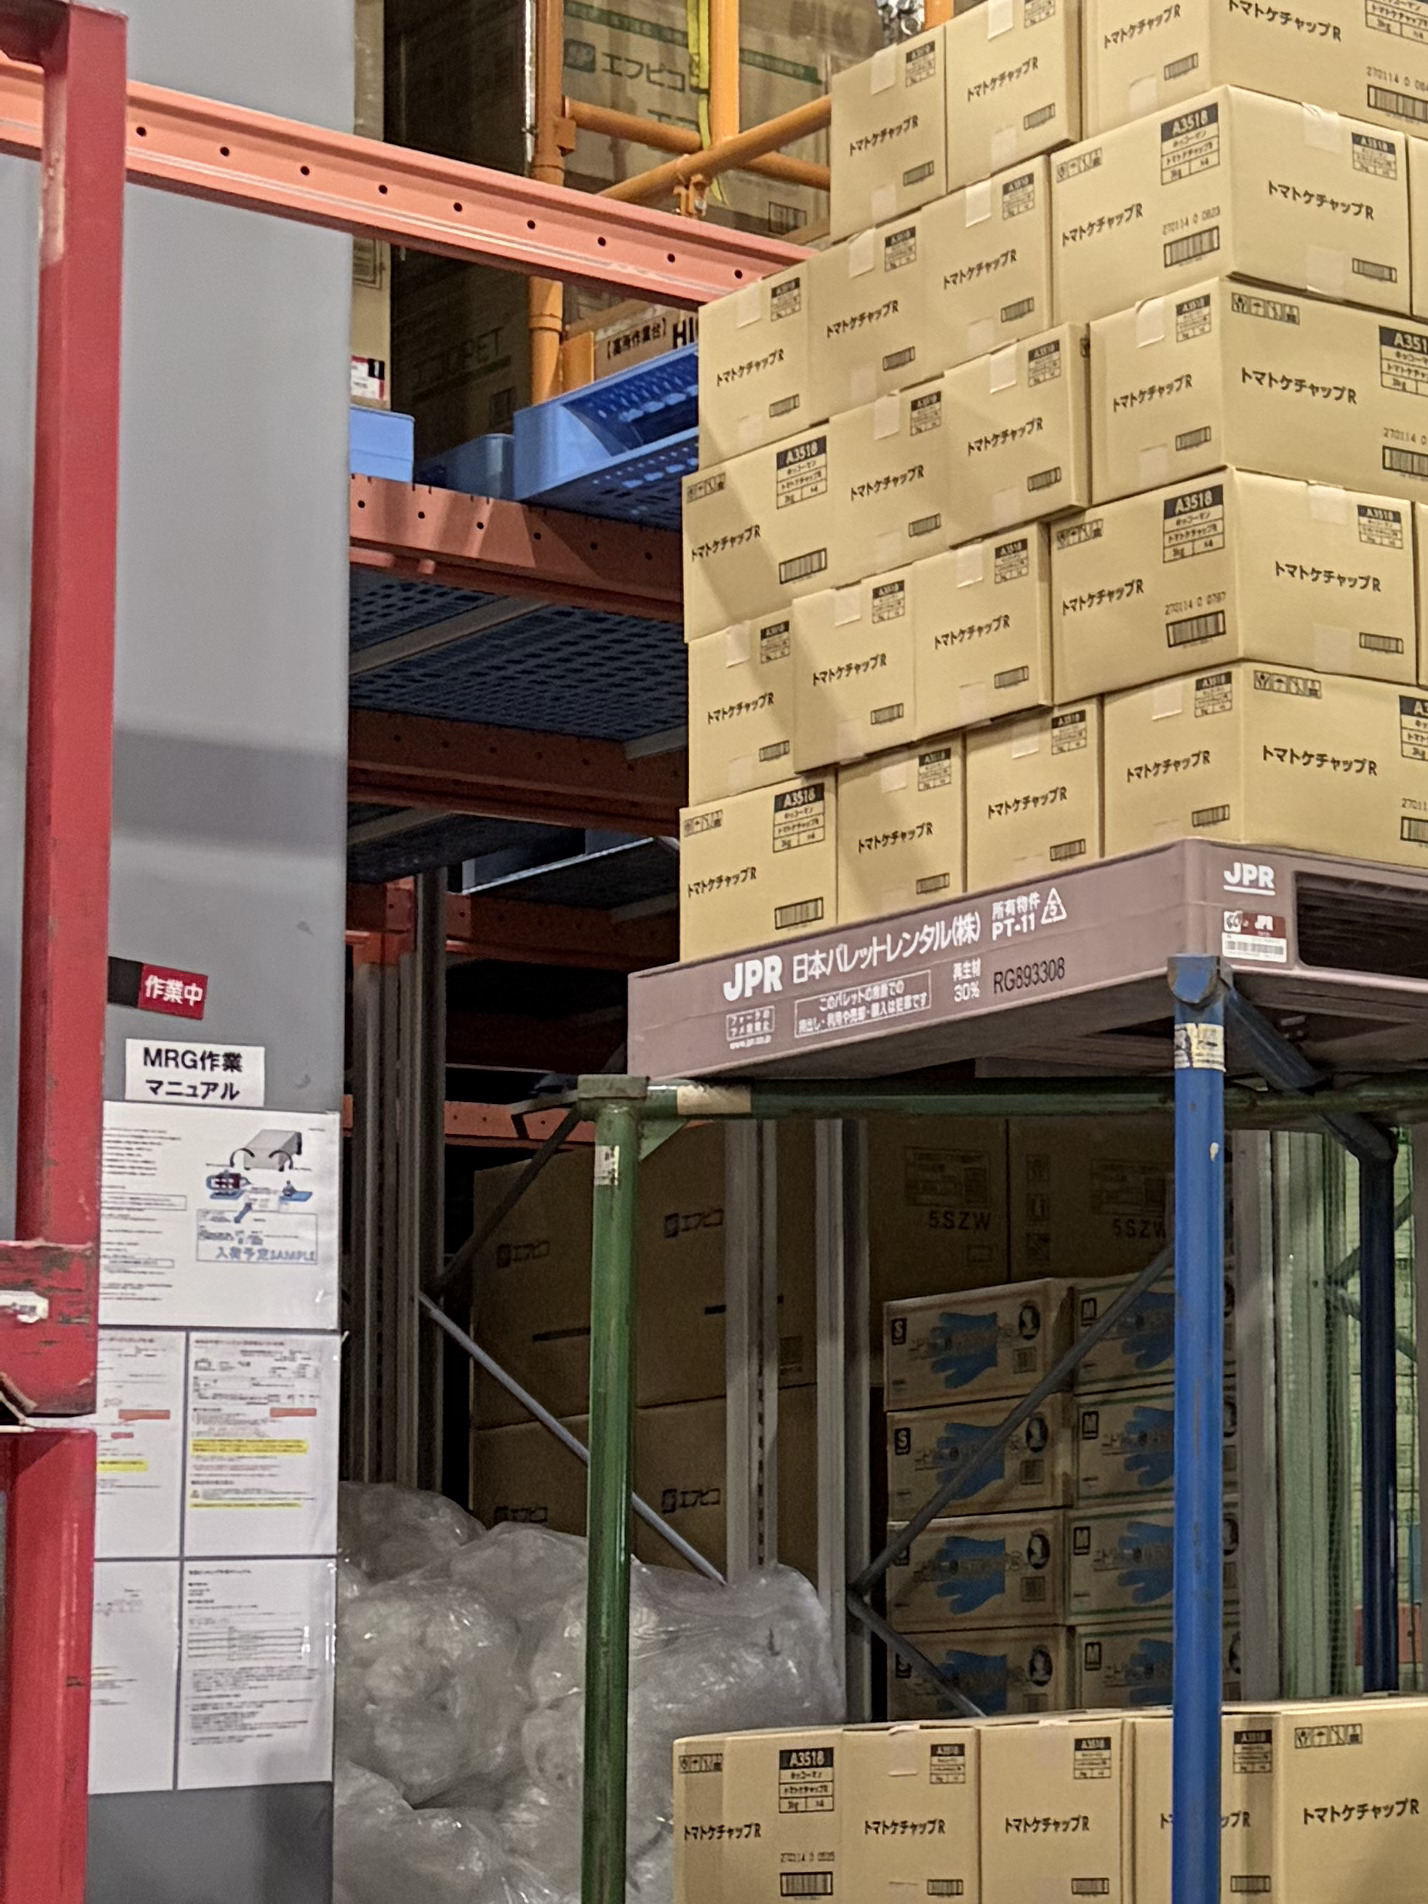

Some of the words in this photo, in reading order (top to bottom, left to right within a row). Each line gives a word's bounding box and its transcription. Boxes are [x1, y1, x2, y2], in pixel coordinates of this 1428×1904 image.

[850, 115, 918, 156] トマトケチャップR
[1269, 181, 1374, 220] トマトケチャップR
[944, 249, 1016, 289] トマトケチャップR
[717, 349, 783, 386] トマトケチャップR
[1242, 367, 1357, 404] トマトケチャップR
[851, 465, 924, 501] トマトケチャップR
[1275, 561, 1381, 592] トマトケチャップR
[935, 615, 1009, 649] トマトケチャップR
[1263, 745, 1377, 776] トマトケチャップR
[785, 790, 816, 807] A3518
[859, 822, 933, 854] トマトケチャップR
[688, 867, 756, 897] トマトケチャップR
[1224, 862, 1274, 888] JPR
[992, 914, 1035, 941] PT-11
[723, 955, 782, 1001] JPR
[793, 912, 981, 984] 日本パレットレンタル(株)
[144, 975, 204, 1007] 作業中
[993, 957, 1065, 994] RG893308
[954, 983, 979, 1002] 30%
[143, 1047, 243, 1073] MRG作業
[145, 1079, 240, 1101] マニュアル
[789, 1749, 824, 1765] A3518
[865, 1819, 945, 1835] トマトケチャップR
[1005, 1815, 1089, 1833] トマトケチャップR
[1304, 1798, 1419, 1825] トマトケチャップR
[684, 1823, 761, 1841] トマトケチャップR
